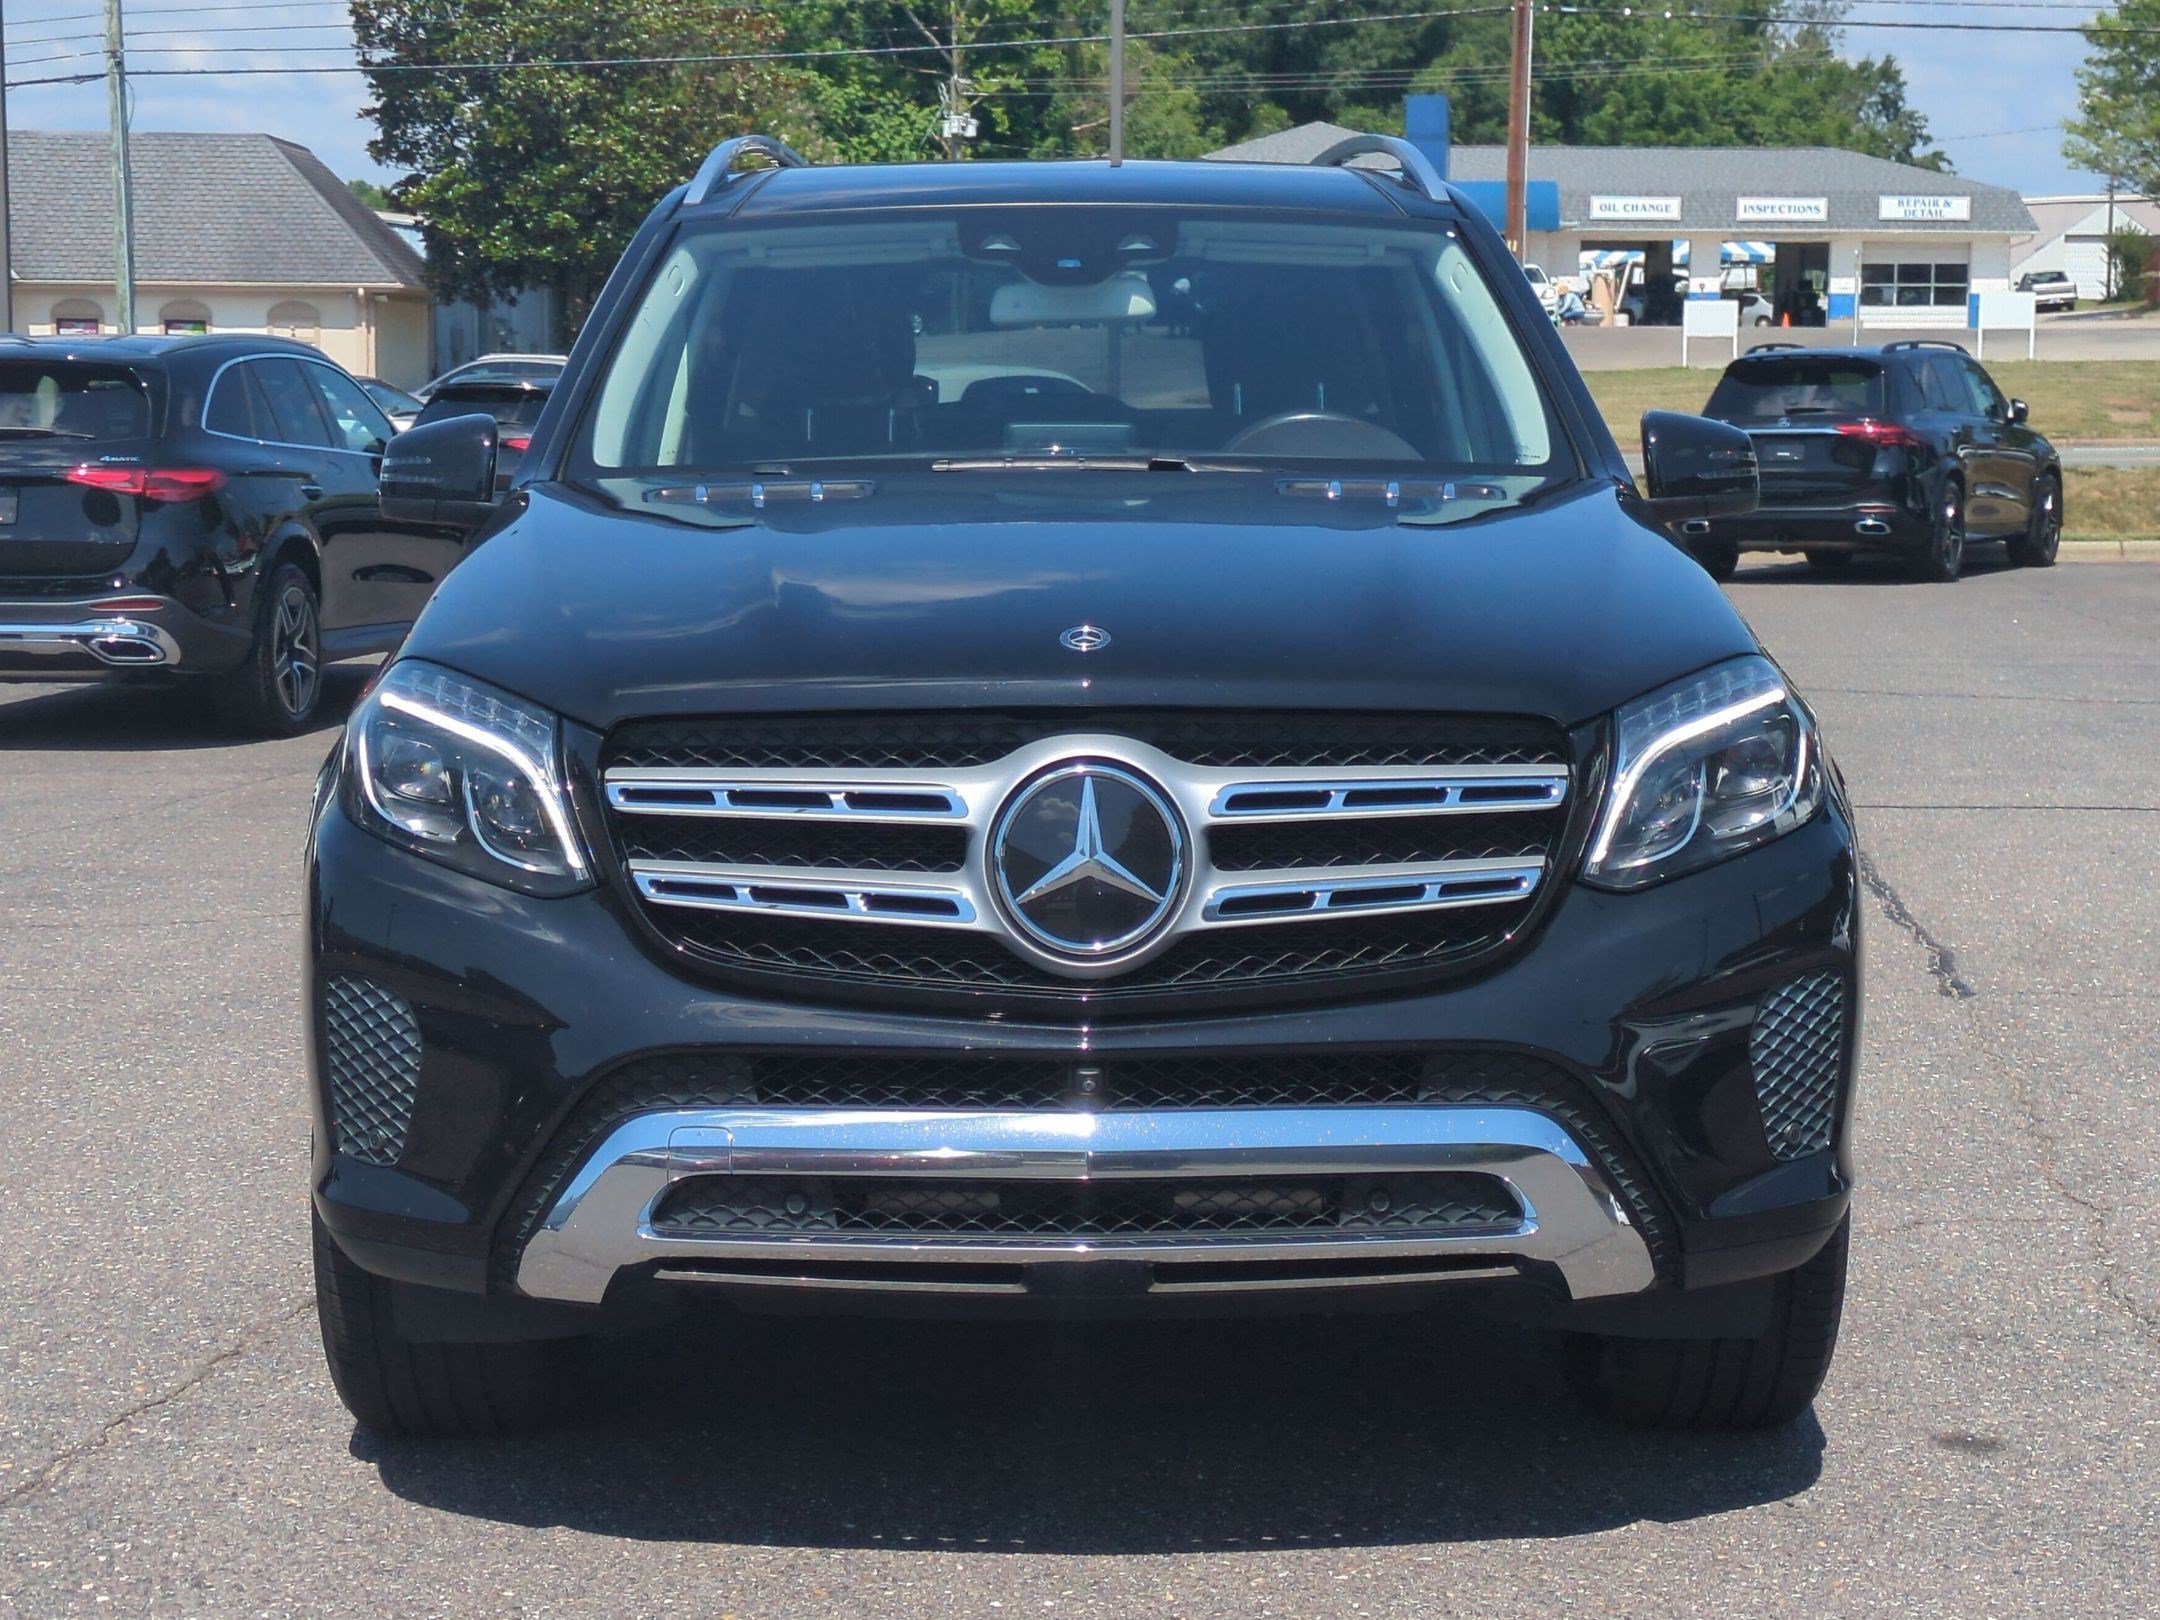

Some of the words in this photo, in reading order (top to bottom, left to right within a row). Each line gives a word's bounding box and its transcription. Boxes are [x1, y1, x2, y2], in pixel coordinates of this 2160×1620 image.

[1897, 197, 1940, 208] REPAIR
[1943, 198, 1952, 208] &
[1599, 203, 1619, 213] OIL
[1623, 203, 1671, 213] CHANGE
[1743, 204, 1822, 215] INSPECTIONS
[1903, 209, 1945, 218] DETAIL
